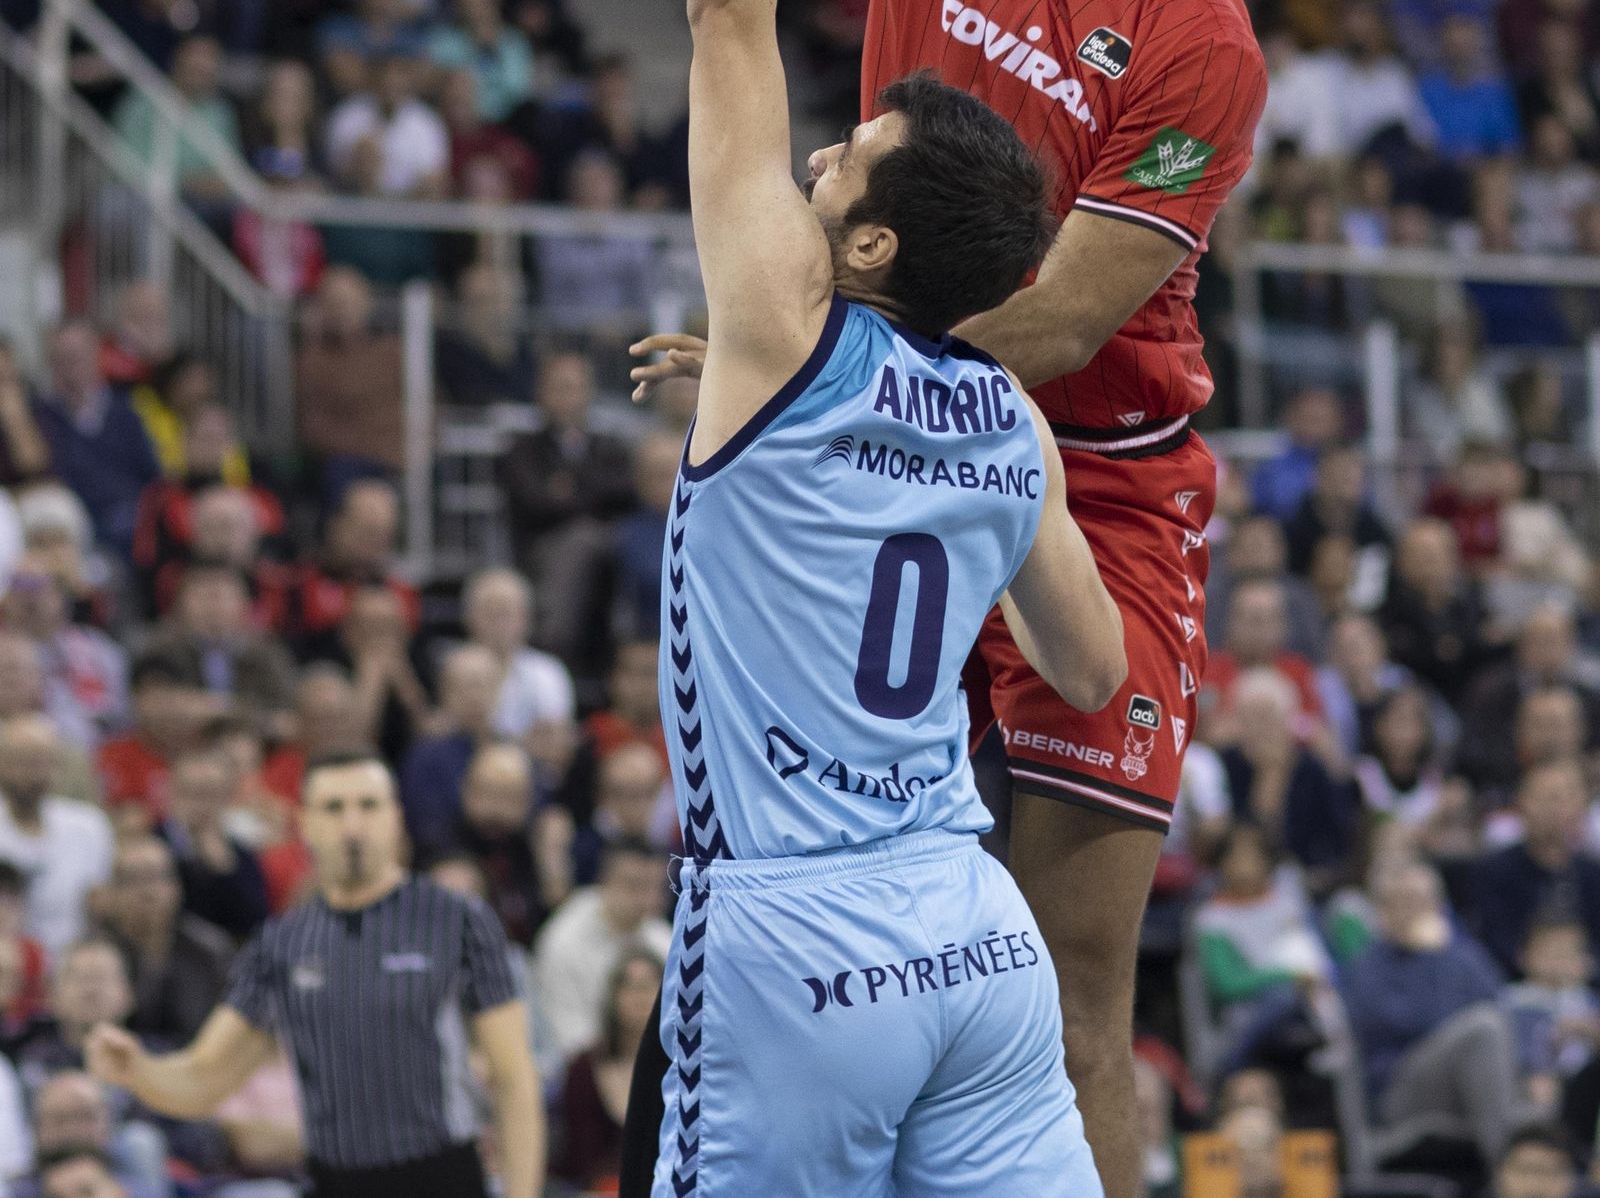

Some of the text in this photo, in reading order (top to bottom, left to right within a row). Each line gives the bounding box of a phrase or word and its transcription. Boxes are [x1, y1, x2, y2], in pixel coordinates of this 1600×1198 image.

[1082, 45, 1121, 74] endesa
[1088, 35, 1108, 52] liga
[856, 439, 1040, 501] MORABANC
[854, 532, 949, 720] 0
[1132, 707, 1155, 724] acb
[1013, 730, 1114, 770] BERNER
